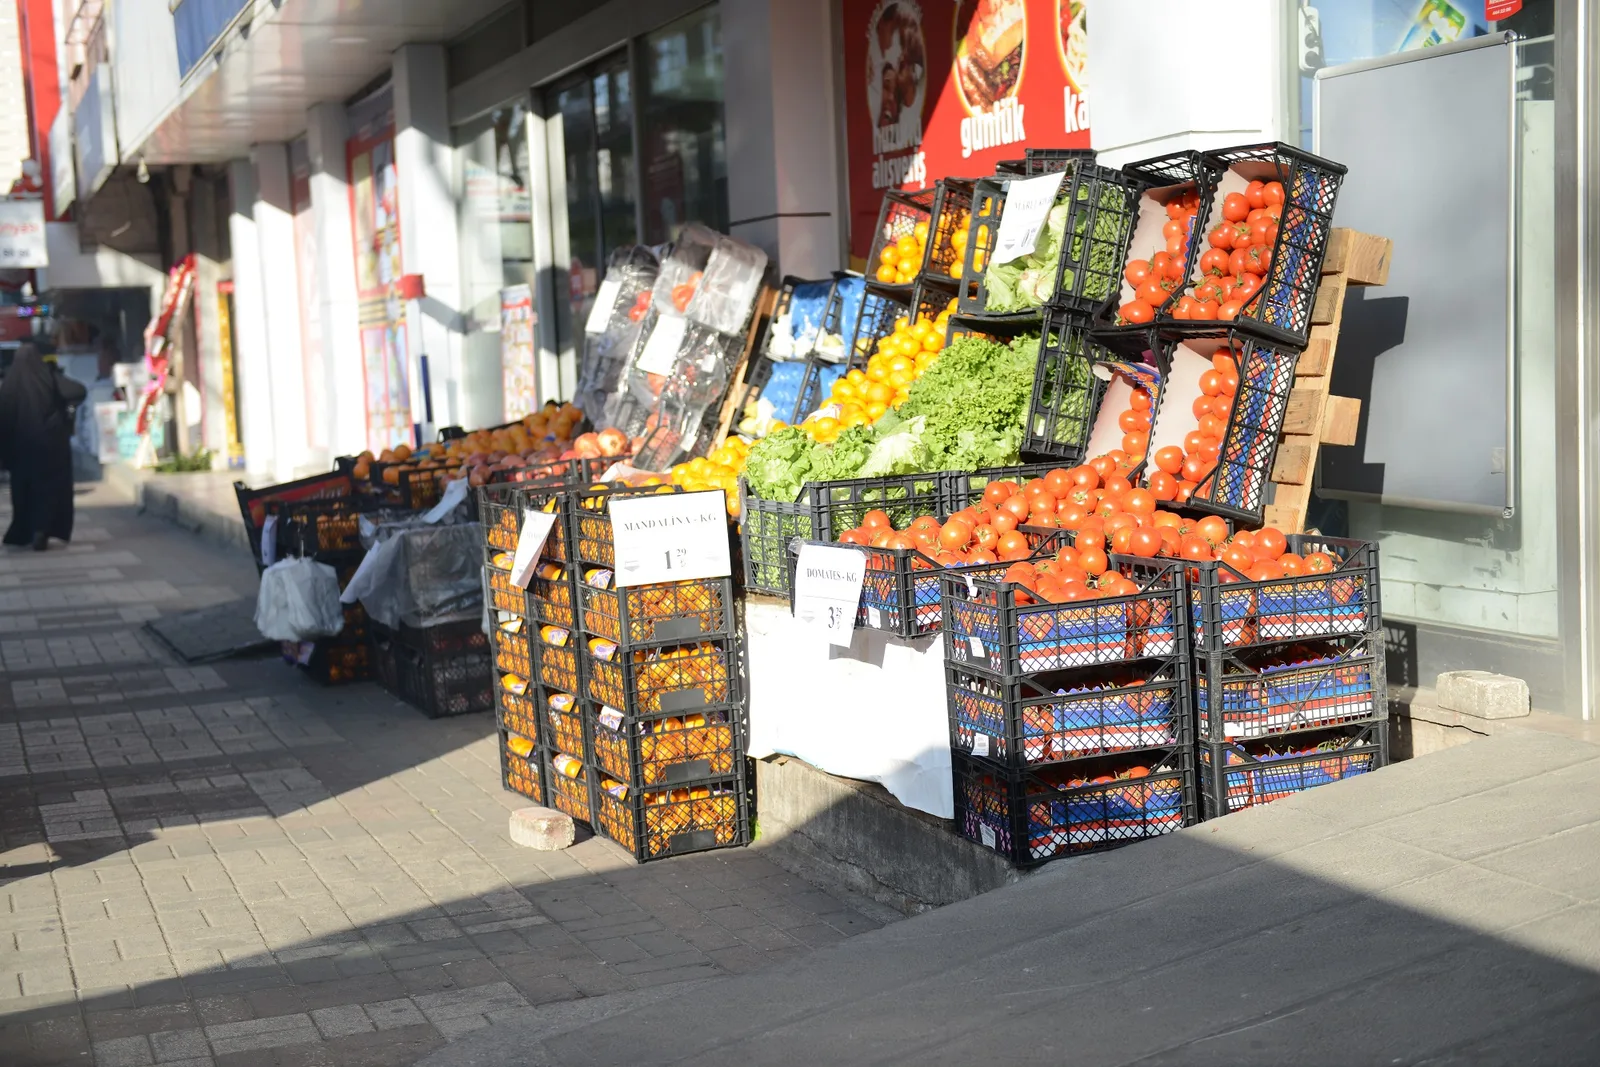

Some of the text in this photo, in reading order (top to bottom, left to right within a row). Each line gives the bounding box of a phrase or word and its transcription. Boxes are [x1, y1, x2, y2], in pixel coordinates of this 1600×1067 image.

[961, 96, 1026, 158] günlük
[872, 151, 926, 190] alışveriş
[624, 515, 690, 530] MANDALİNA
[700, 513, 716, 523] KG
[806, 568, 841, 582] DOMATES
[846, 571, 857, 583] KG
